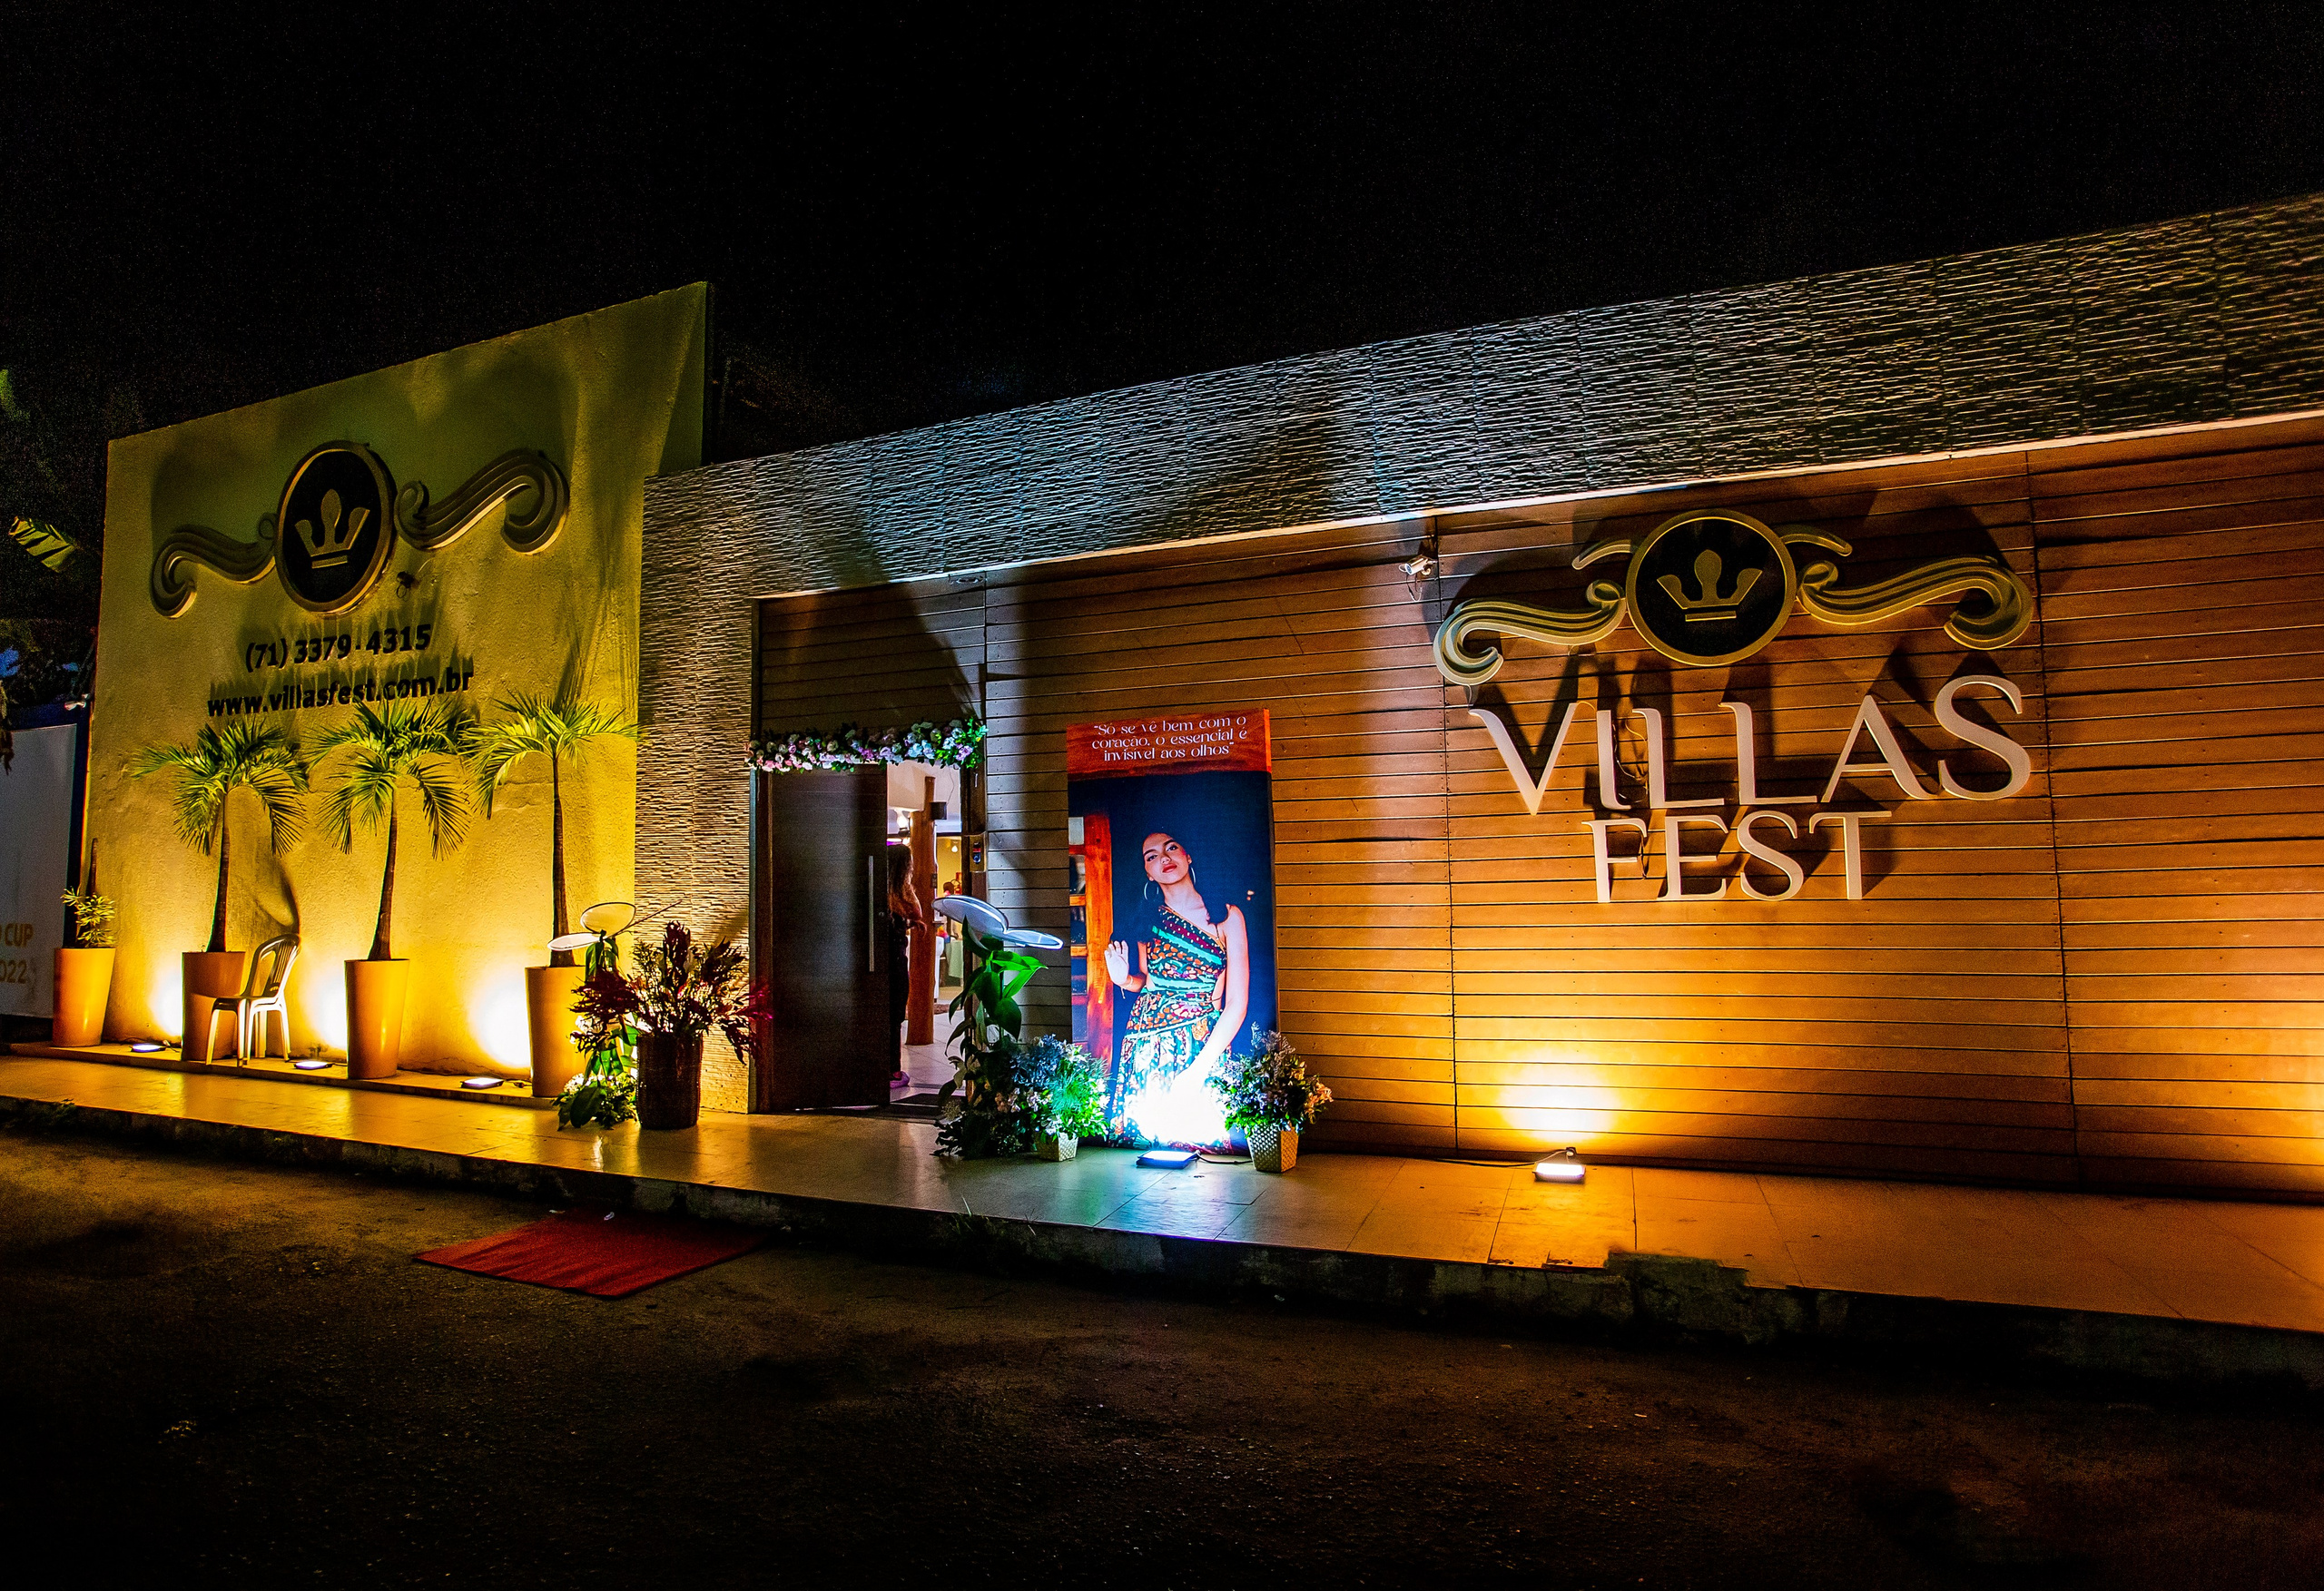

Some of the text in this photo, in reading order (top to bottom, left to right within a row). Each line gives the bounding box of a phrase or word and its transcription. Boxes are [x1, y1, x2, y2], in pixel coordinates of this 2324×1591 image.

[245, 637, 289, 673] (71)
[207, 666, 475, 717] www.villasfest.com.br
[1120, 724, 1136, 734] se
[1140, 720, 1157, 733] vê
[1162, 720, 1193, 732] bem
[1198, 717, 1230, 729] com
[1236, 715, 1246, 725] o
[1155, 736, 1166, 746] o
[1170, 728, 1234, 745] essencial
[1238, 726, 1247, 740] é
[1104, 747, 1155, 761] invisível
[1160, 749, 1186, 759] aos
[1468, 674, 2032, 815] VILLAS
[1581, 810, 1892, 903] FEST
[5, 923, 34, 948] CUP
